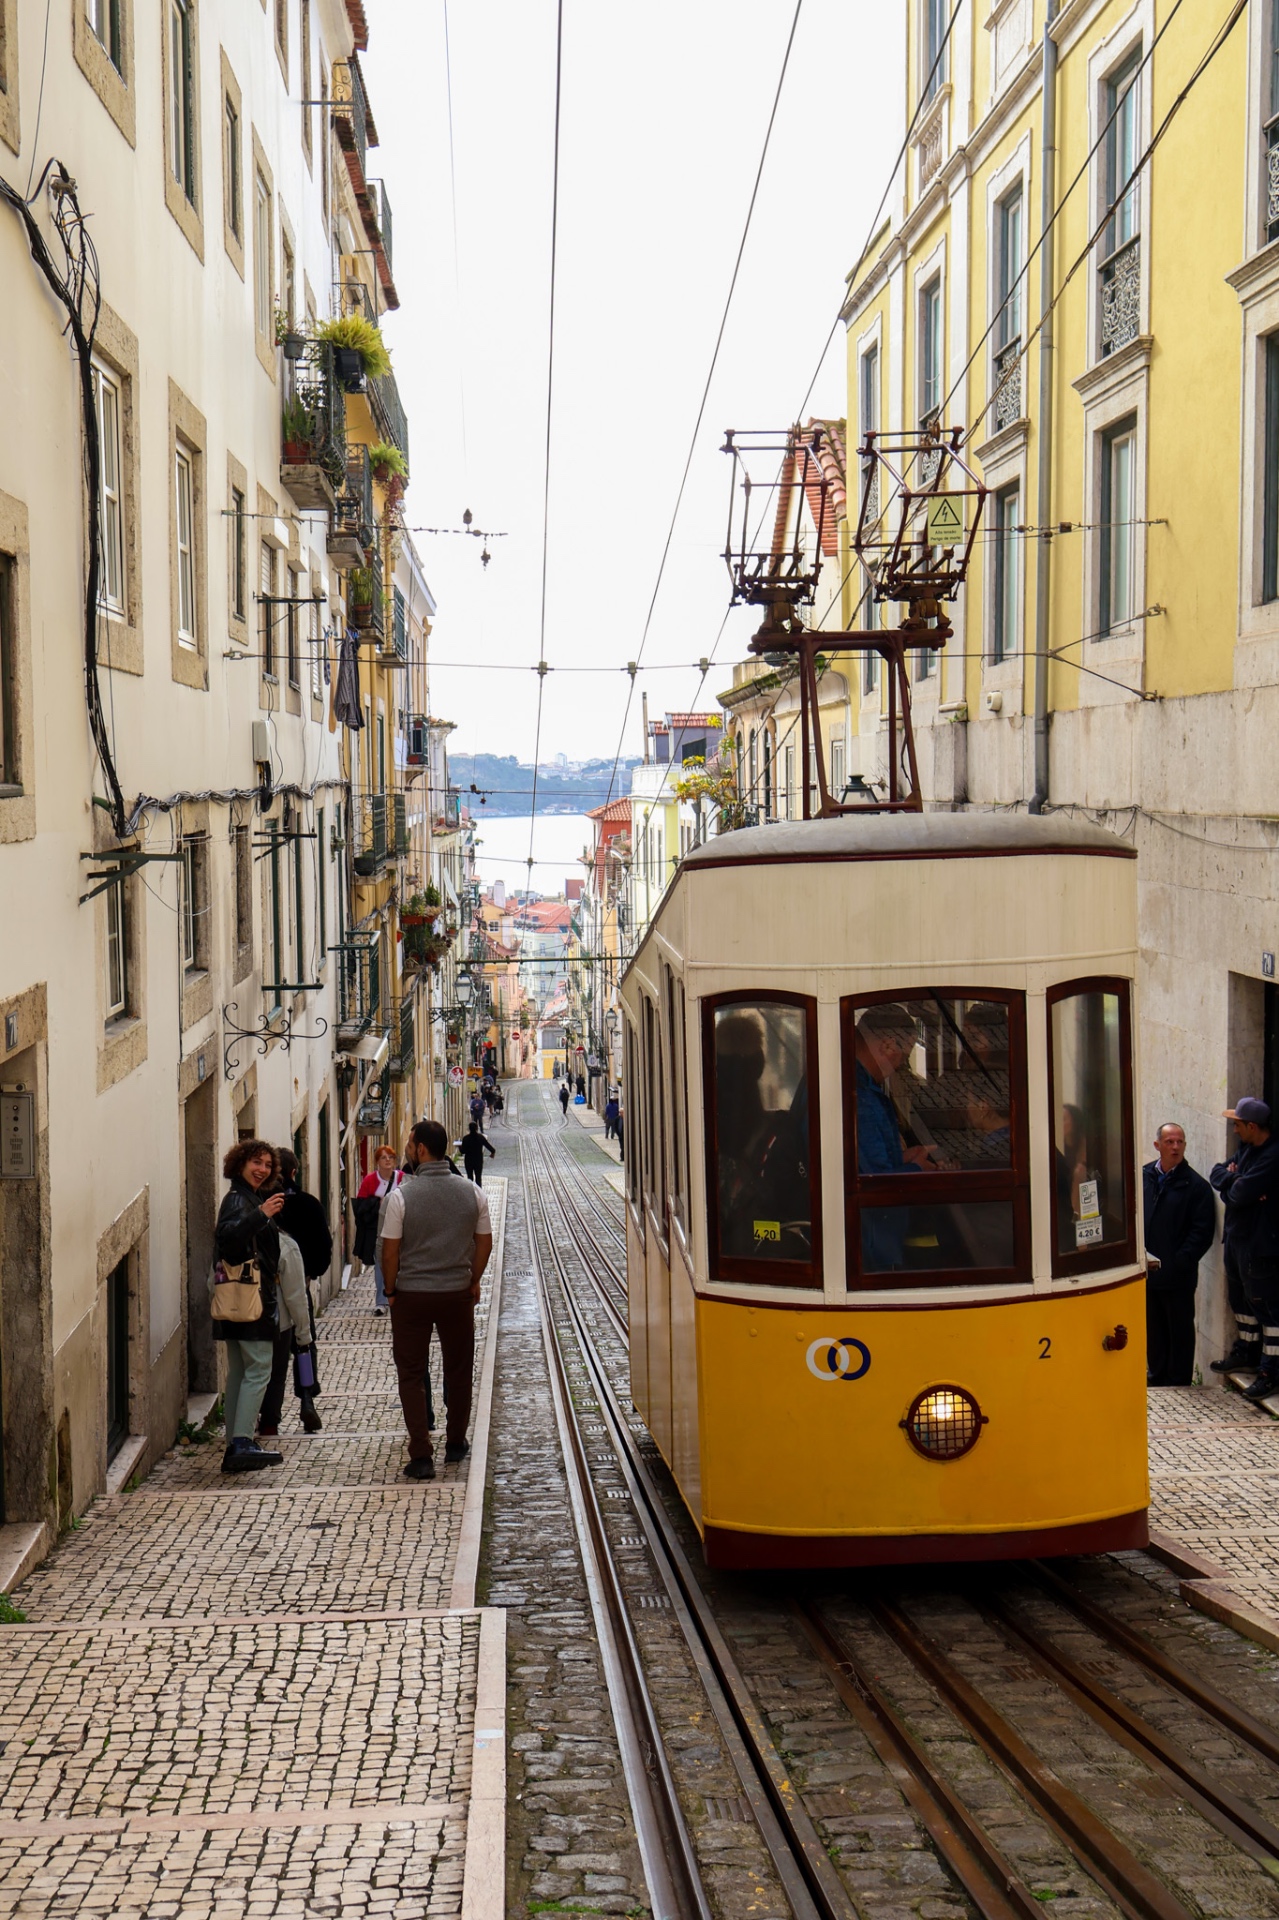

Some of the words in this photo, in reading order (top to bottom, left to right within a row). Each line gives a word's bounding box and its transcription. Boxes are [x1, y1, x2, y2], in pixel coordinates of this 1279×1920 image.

[754, 1229, 776, 1241] 4.20
[1078, 1228, 1094, 1239] 4.20
[1095, 1227, 1100, 1235] €
[1038, 1337, 1052, 1360] 2
